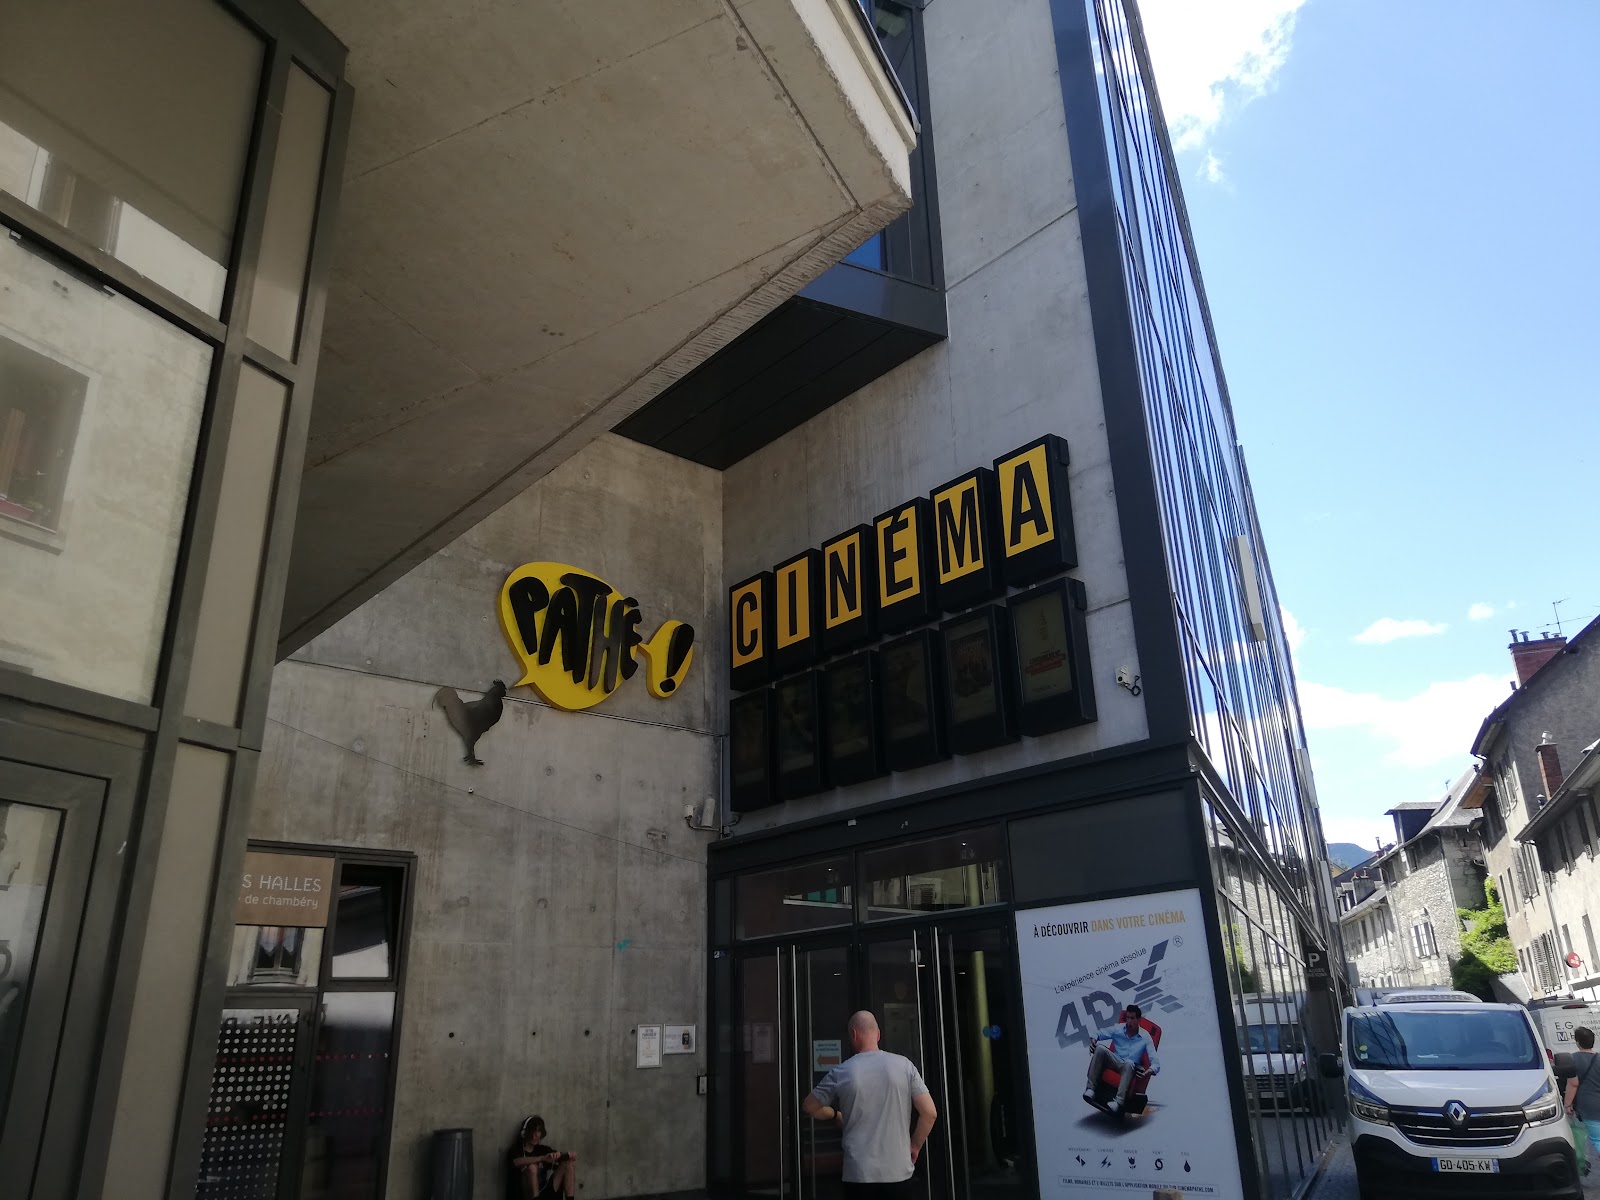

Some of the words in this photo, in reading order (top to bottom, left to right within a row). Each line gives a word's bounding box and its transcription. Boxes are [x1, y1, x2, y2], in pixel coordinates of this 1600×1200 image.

[735, 458, 1050, 658] CINÉMA
[259, 874, 322, 893] HALLES
[244, 893, 259, 905] de
[262, 894, 319, 910] chambéry
[1033, 924, 1040, 938] À
[1041, 921, 1089, 938] DÉCOUVRIR
[1091, 918, 1115, 932] DANS
[1117, 914, 1145, 929] VOTRE
[1148, 909, 1186, 926] CINÉMA
[1054, 971, 1095, 994] L'expérience
[1095, 959, 1120, 976] cinéma
[1120, 947, 1147, 965] absolue
[1308, 952, 1320, 968] P
